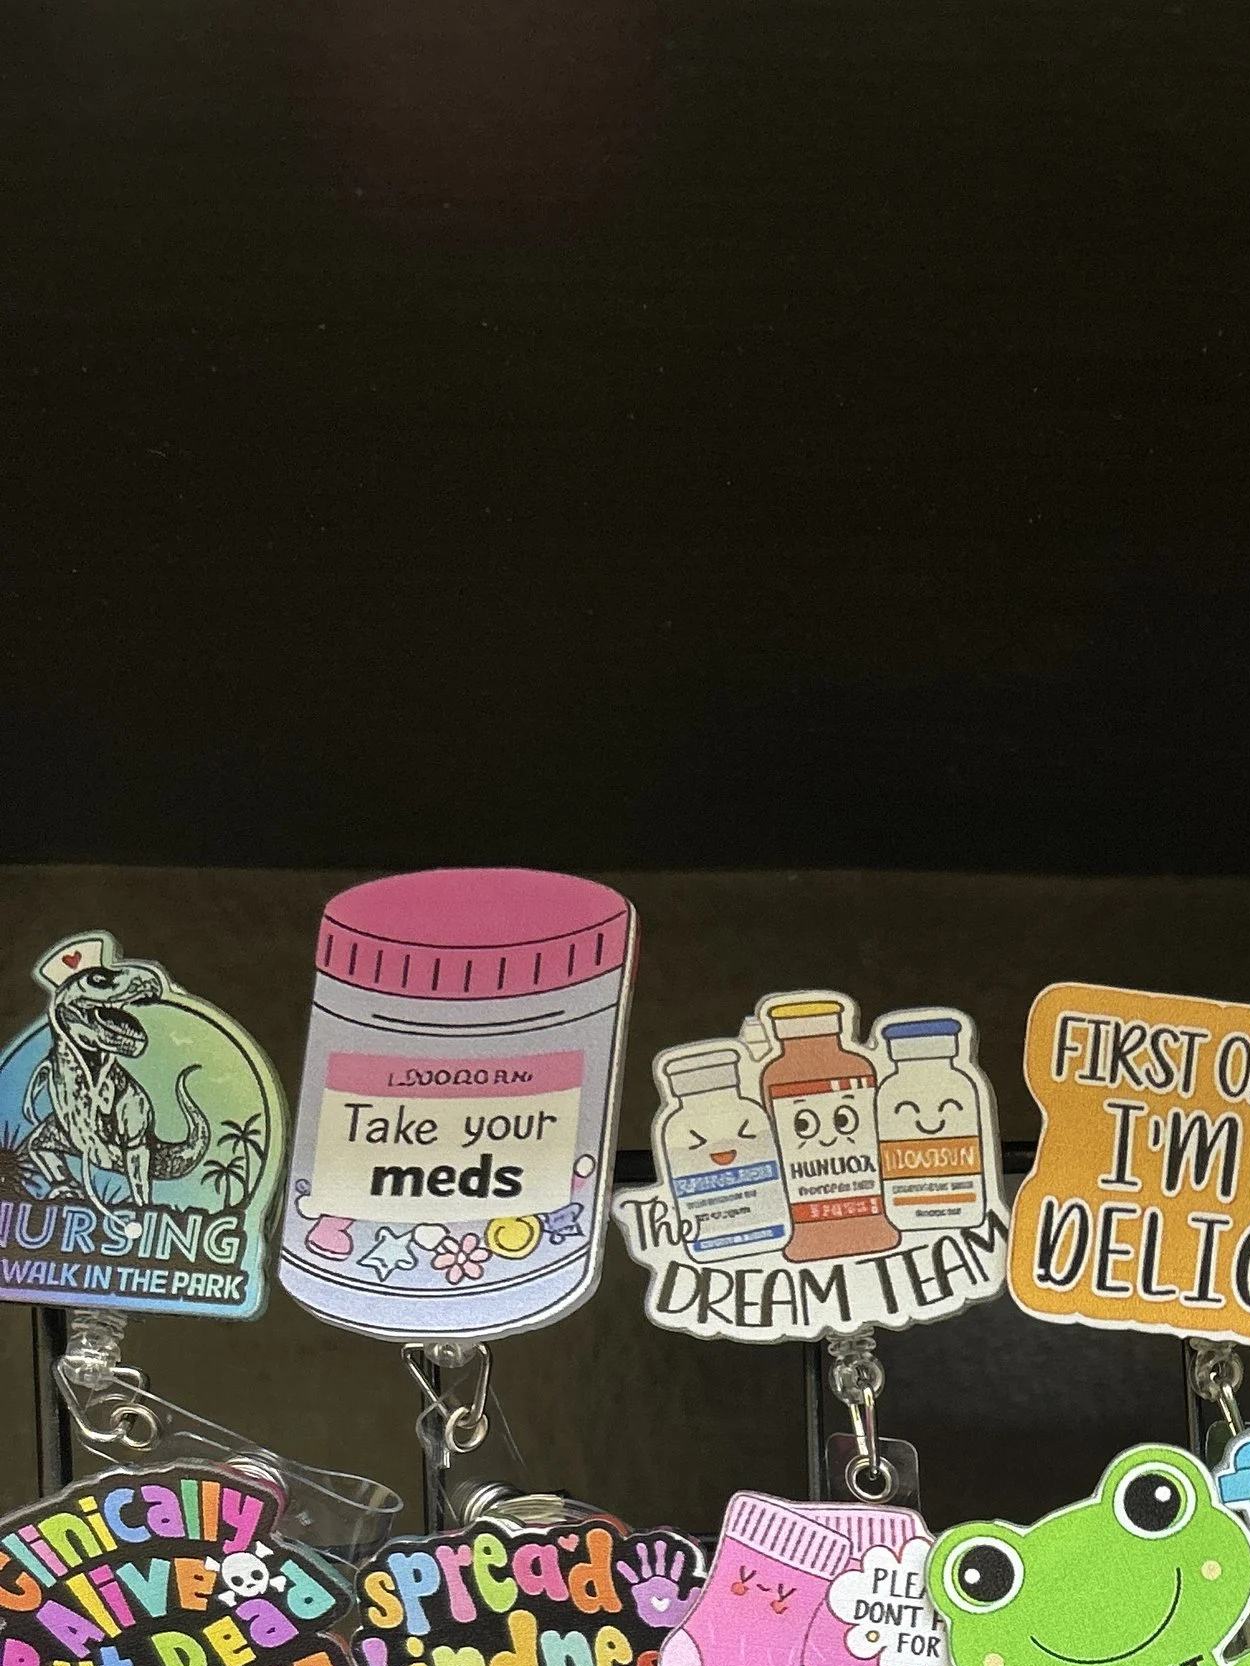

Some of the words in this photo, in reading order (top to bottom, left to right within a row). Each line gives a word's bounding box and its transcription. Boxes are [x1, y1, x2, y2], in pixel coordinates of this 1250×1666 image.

[1055, 1015, 1207, 1088] FIRST
[344, 1103, 438, 1147] Take
[461, 1110, 557, 1150] your
[1100, 1101, 1239, 1196] I'M
[370, 1154, 524, 1199] meds
[621, 1196, 699, 1252] The
[1, 1258, 82, 1288] WALK
[84, 1264, 112, 1290] IN
[117, 1267, 169, 1293] THE
[171, 1271, 243, 1299] PARK
[657, 1259, 851, 1328] DREAM
[855, 1209, 1009, 1315] TEAM
[37, 1557, 216, 1658] Alive
[365, 1528, 623, 1634] spread
[897, 1632, 941, 1658] FOR
